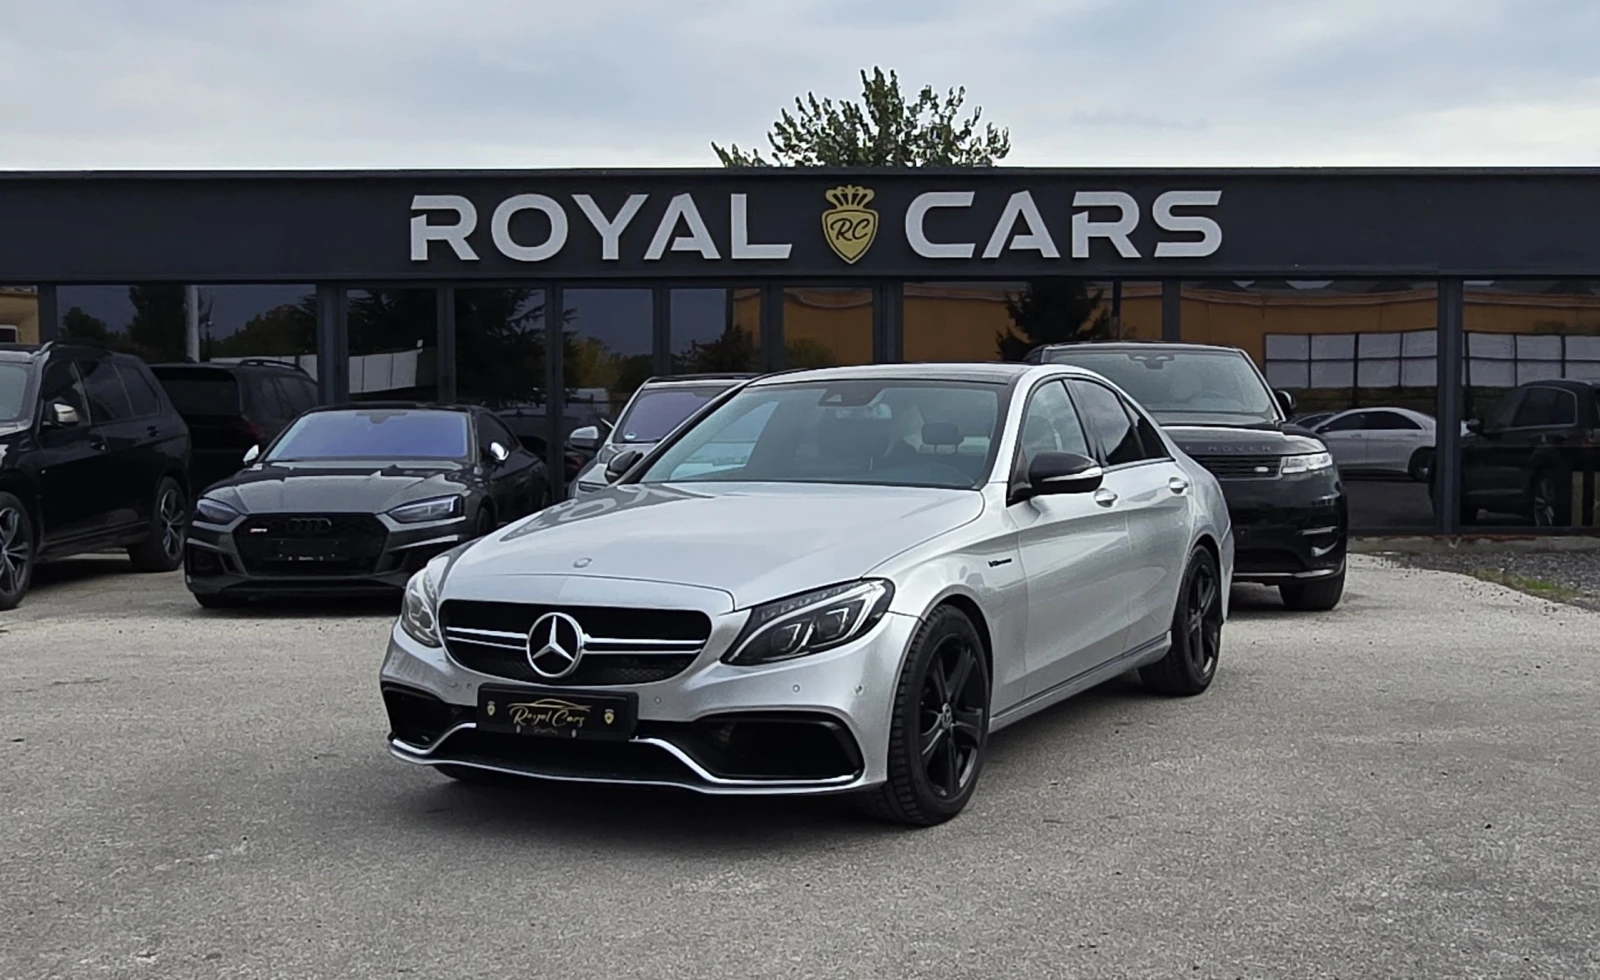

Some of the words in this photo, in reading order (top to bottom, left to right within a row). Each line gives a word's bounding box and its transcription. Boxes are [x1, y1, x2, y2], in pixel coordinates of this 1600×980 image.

[411, 193, 792, 261] ROYAL
[905, 190, 1222, 258] CARS
[830, 218, 870, 241] RC
[509, 706, 552, 726] Royal
[552, 710, 585, 727] Cars
